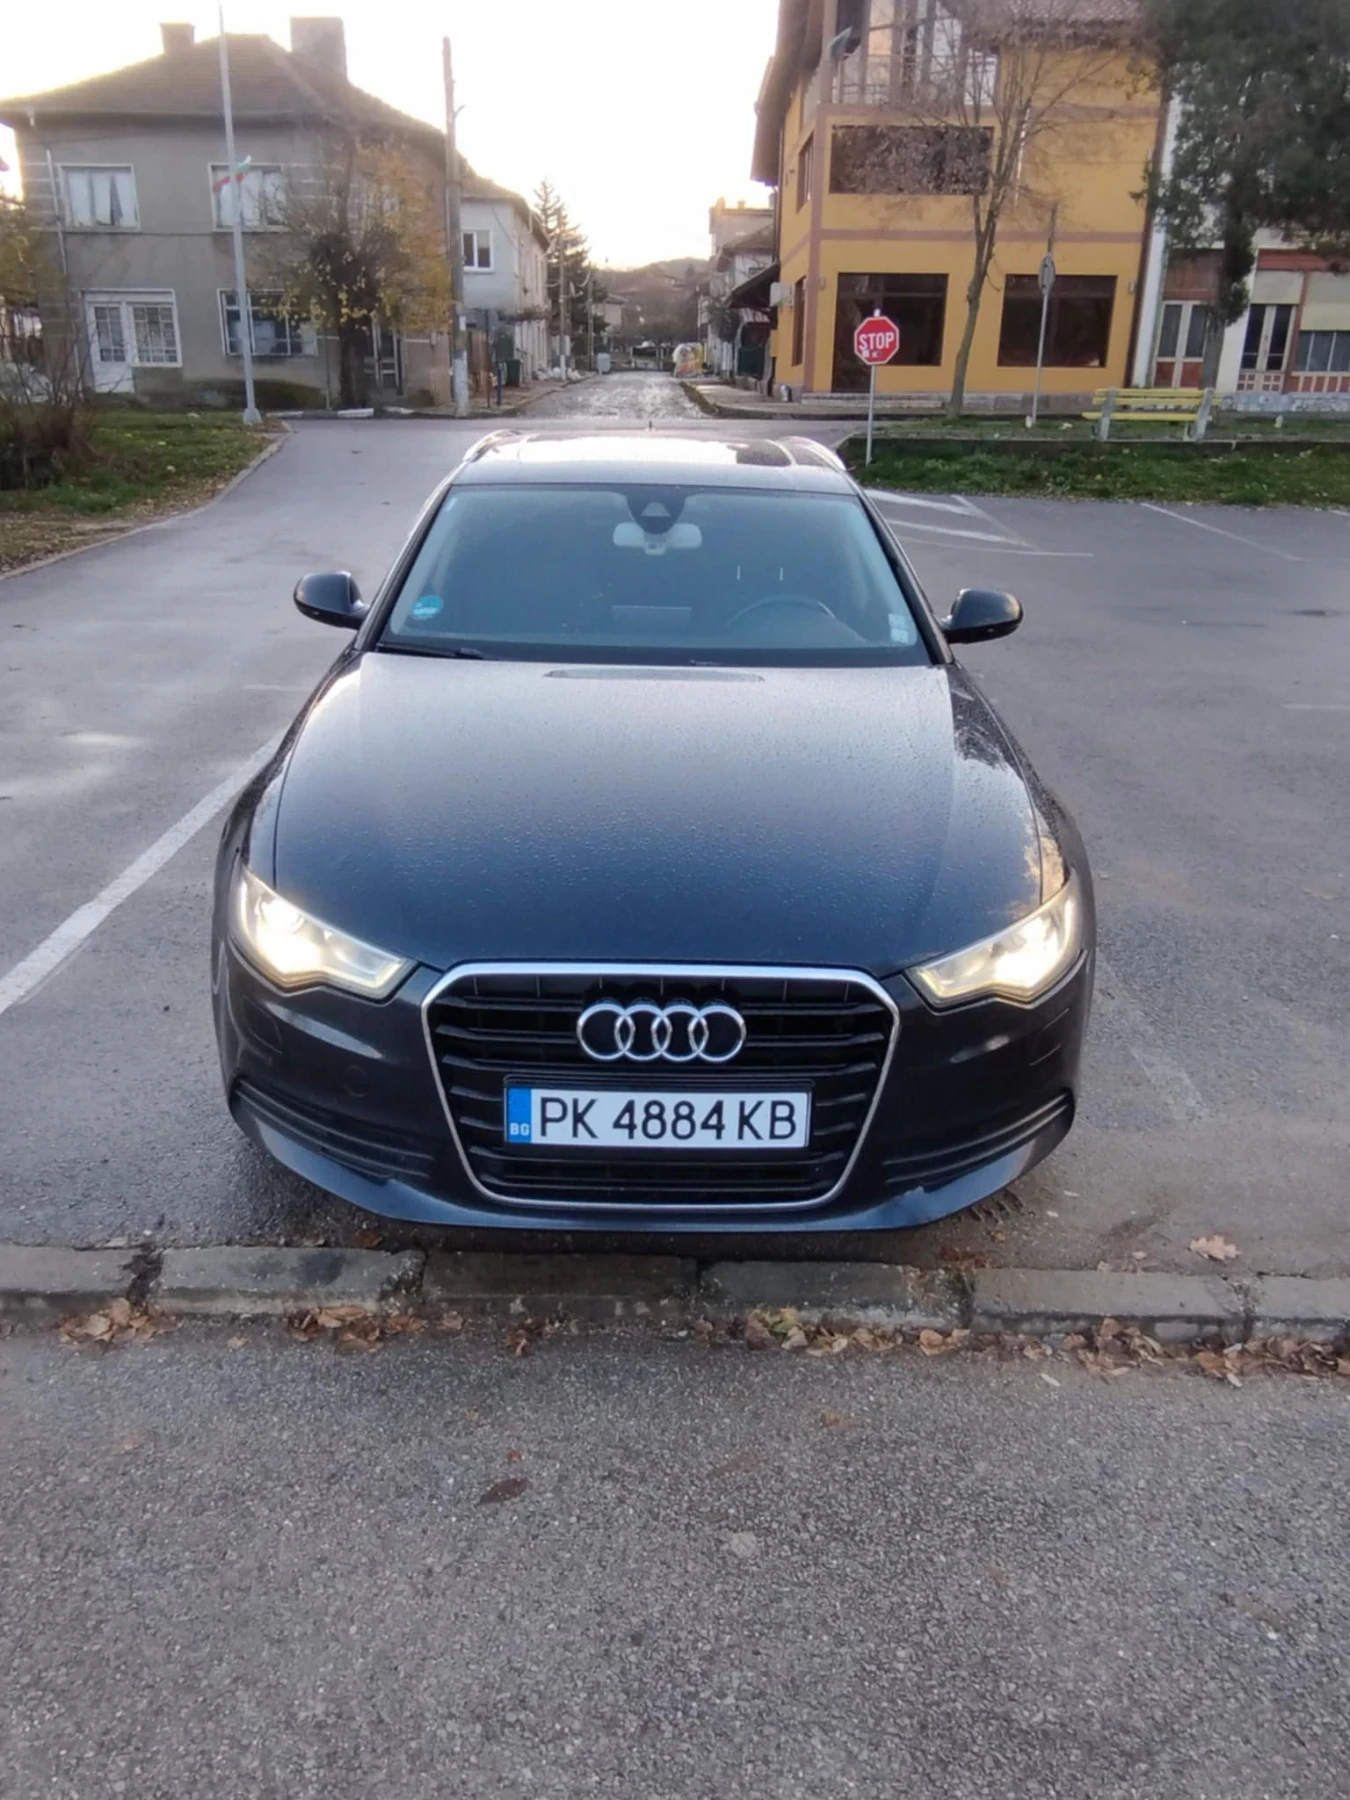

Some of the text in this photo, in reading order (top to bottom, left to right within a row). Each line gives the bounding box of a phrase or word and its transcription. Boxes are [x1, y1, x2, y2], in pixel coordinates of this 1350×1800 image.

[859, 332, 894, 350] STOP
[540, 1096, 797, 1140] PK 4884 KB
[510, 1122, 530, 1136] BG
